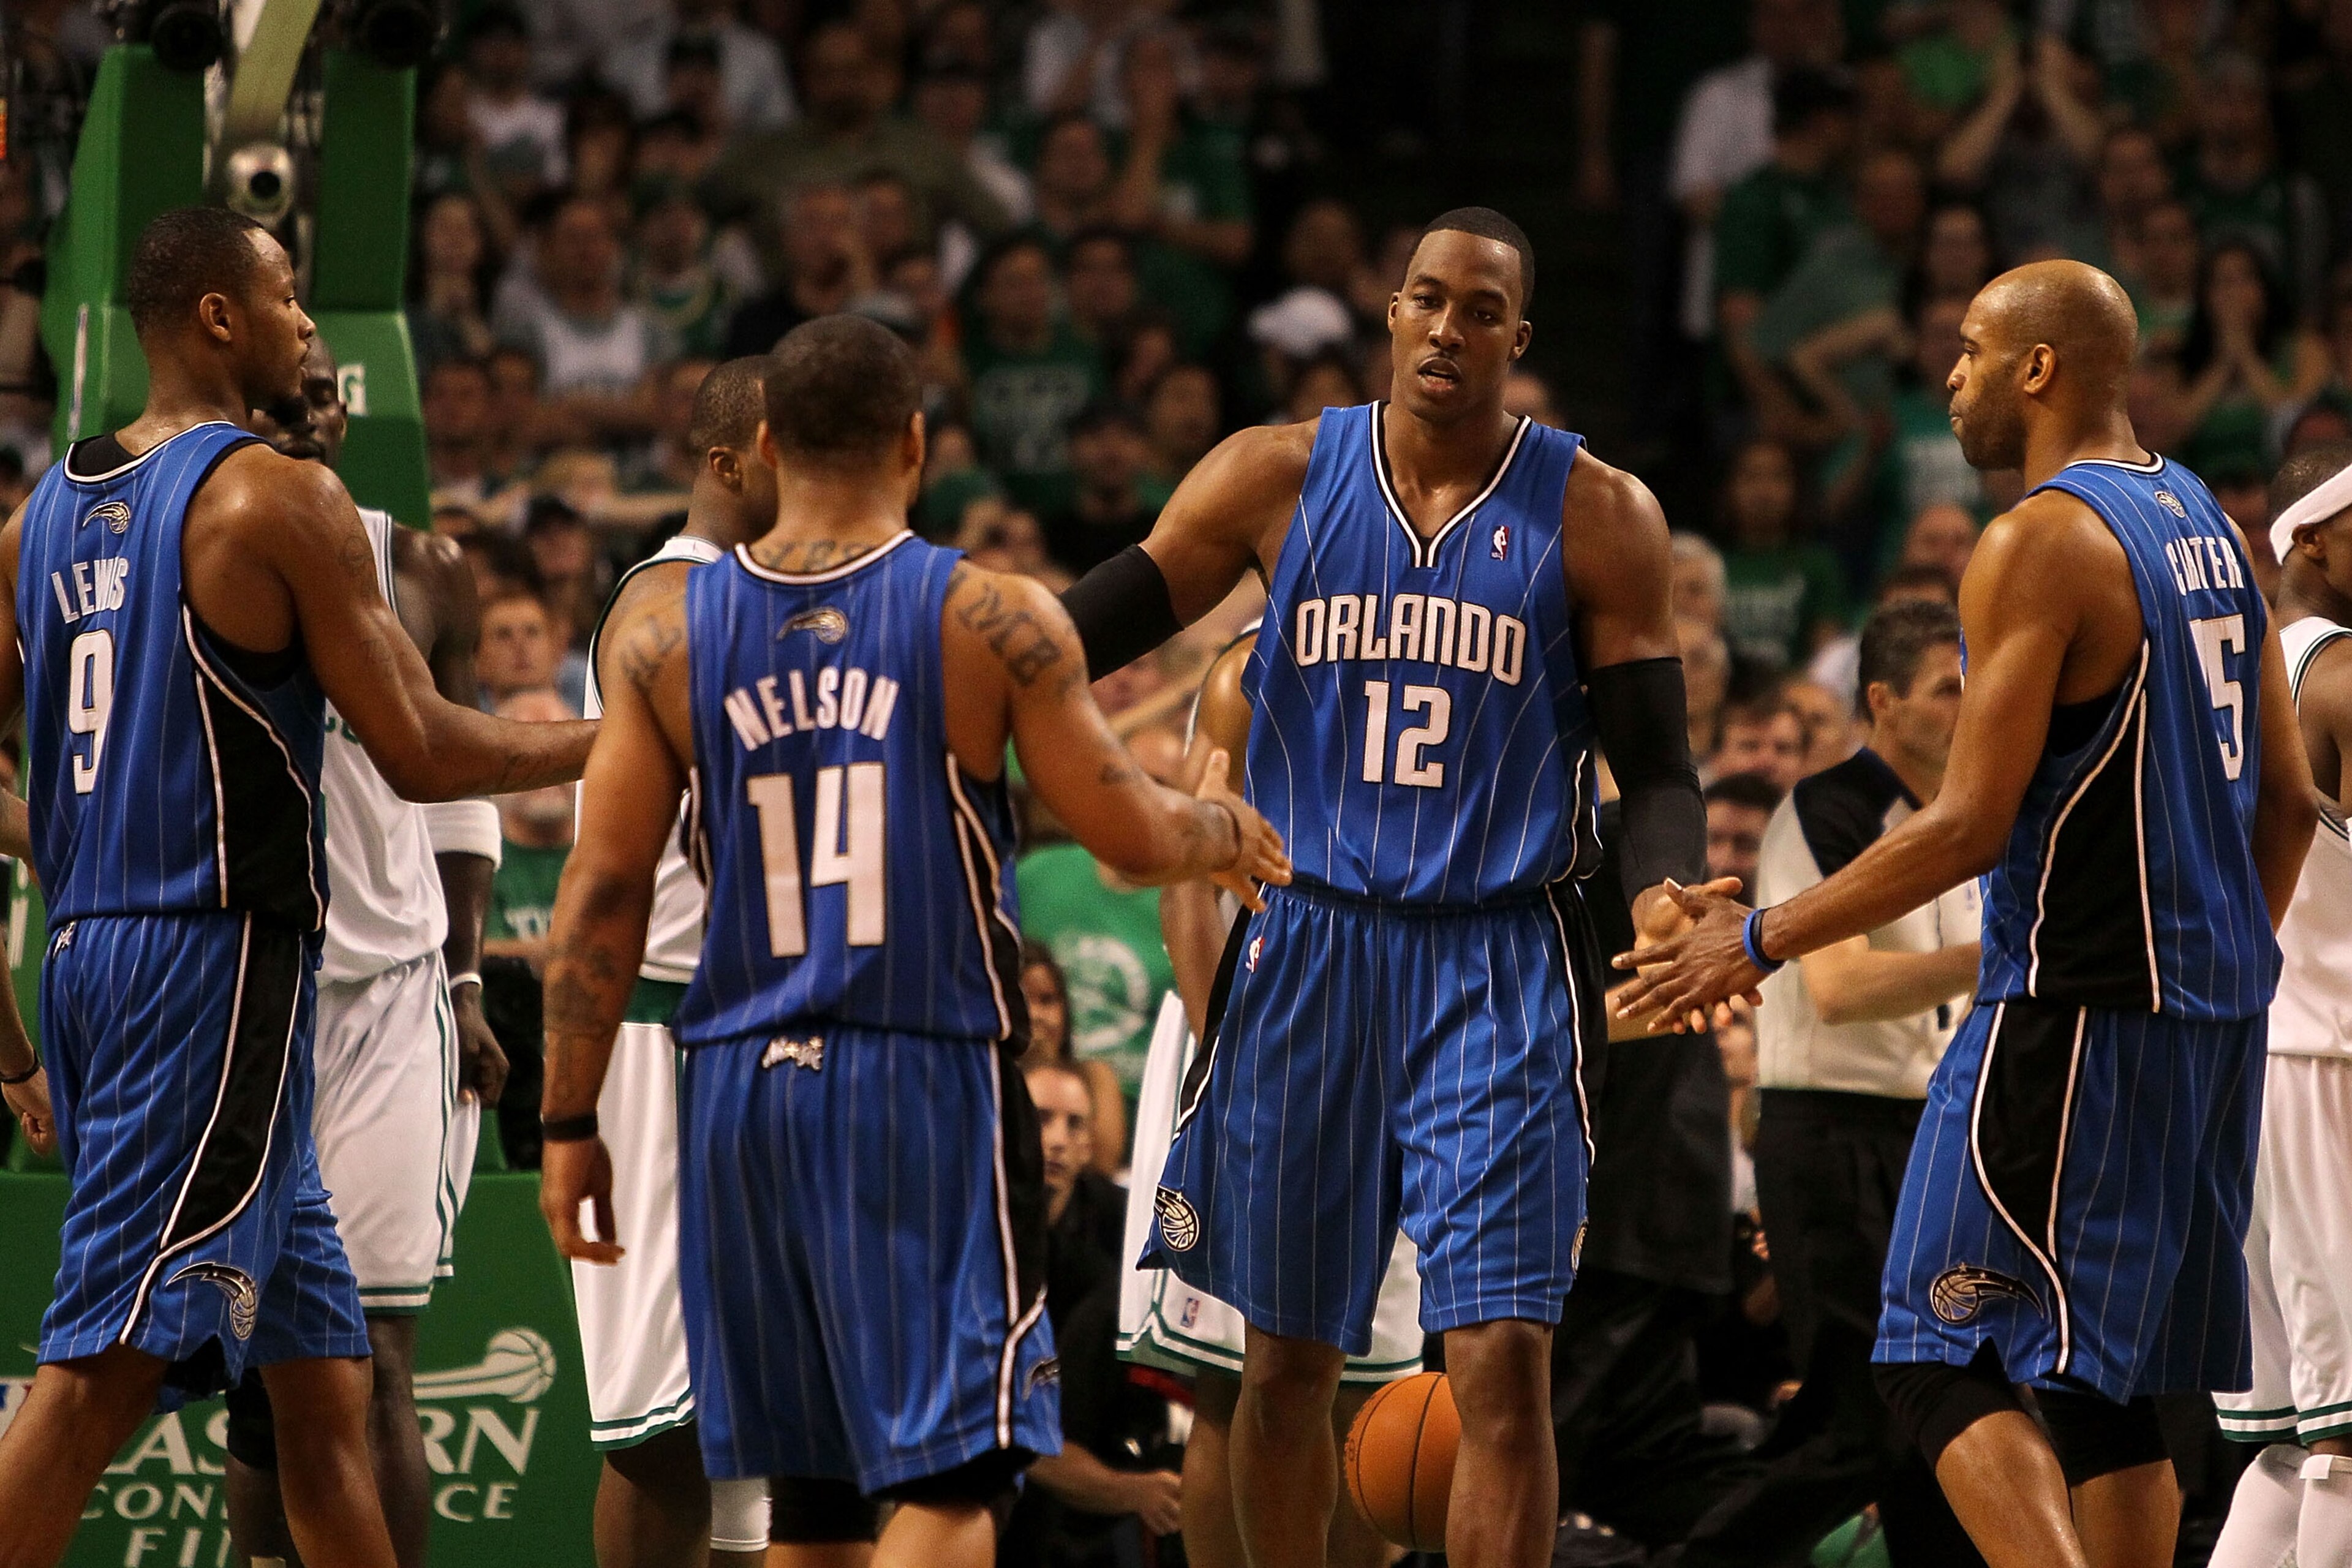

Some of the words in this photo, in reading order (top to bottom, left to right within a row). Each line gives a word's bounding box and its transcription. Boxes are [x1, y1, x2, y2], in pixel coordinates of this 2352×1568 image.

[1295, 593, 1526, 687] ORLANDO
[2189, 613, 2245, 780] 5
[68, 628, 115, 794] 9
[723, 666, 900, 752] NELSON
[1362, 680, 1452, 788] 12
[746, 761, 886, 958] 14
